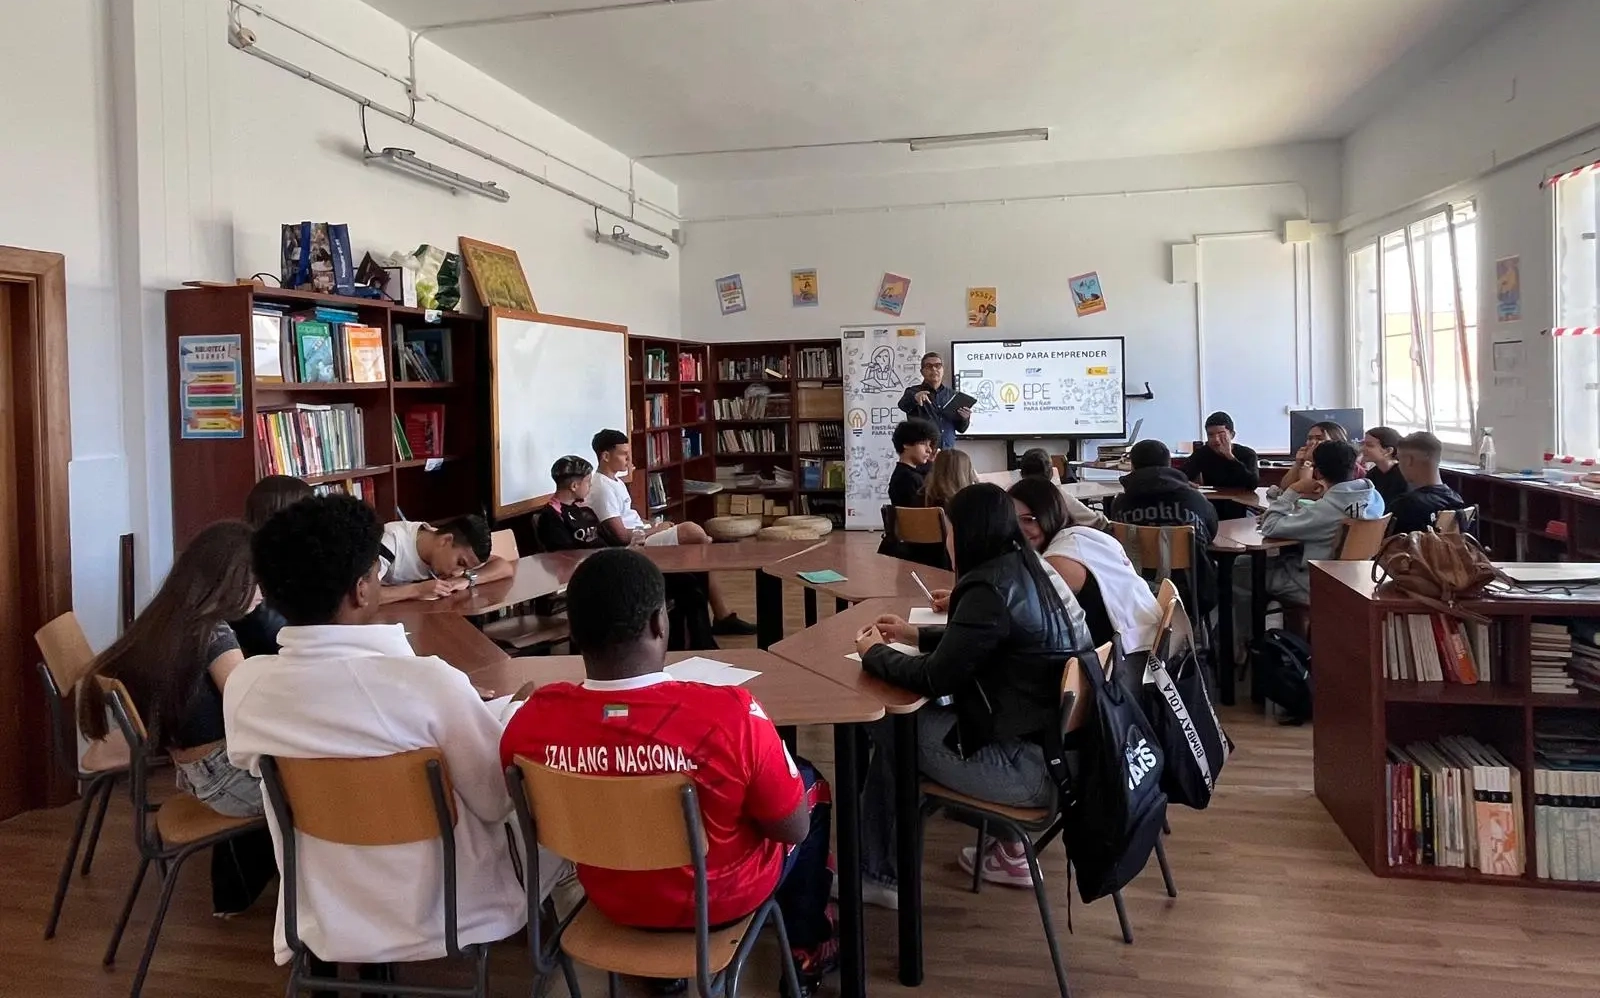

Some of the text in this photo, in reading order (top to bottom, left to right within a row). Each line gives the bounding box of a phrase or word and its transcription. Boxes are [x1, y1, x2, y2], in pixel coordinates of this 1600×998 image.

[966, 350, 1107, 361] CREATIVIDAD PARA EMPRENDER
[1023, 383, 1051, 400] EPE
[871, 407, 899, 424] EPE
